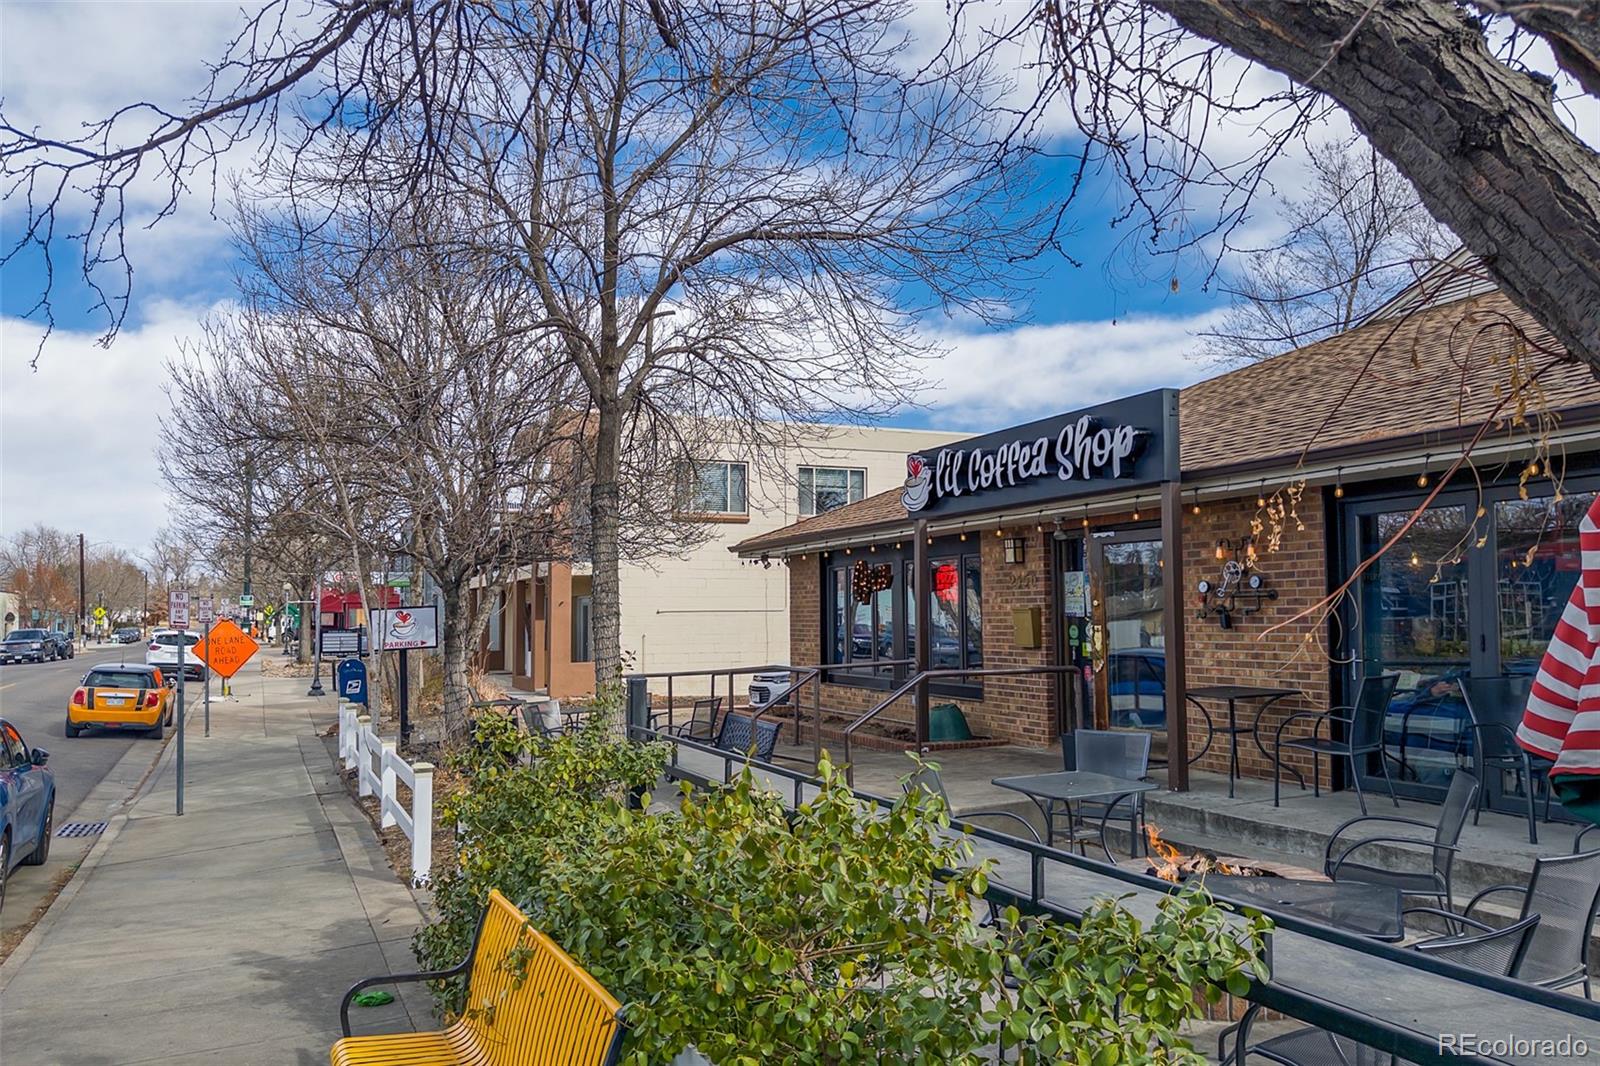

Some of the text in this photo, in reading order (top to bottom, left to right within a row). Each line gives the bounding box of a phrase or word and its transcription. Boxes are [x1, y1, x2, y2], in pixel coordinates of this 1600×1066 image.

[968, 437, 1048, 492] Coffea
[1055, 414, 1138, 480] Shop
[224, 636, 245, 645] LANE
[384, 640, 419, 648] PARKING
[215, 646, 237, 655] ROAD
[214, 656, 240, 665] AHEAD
